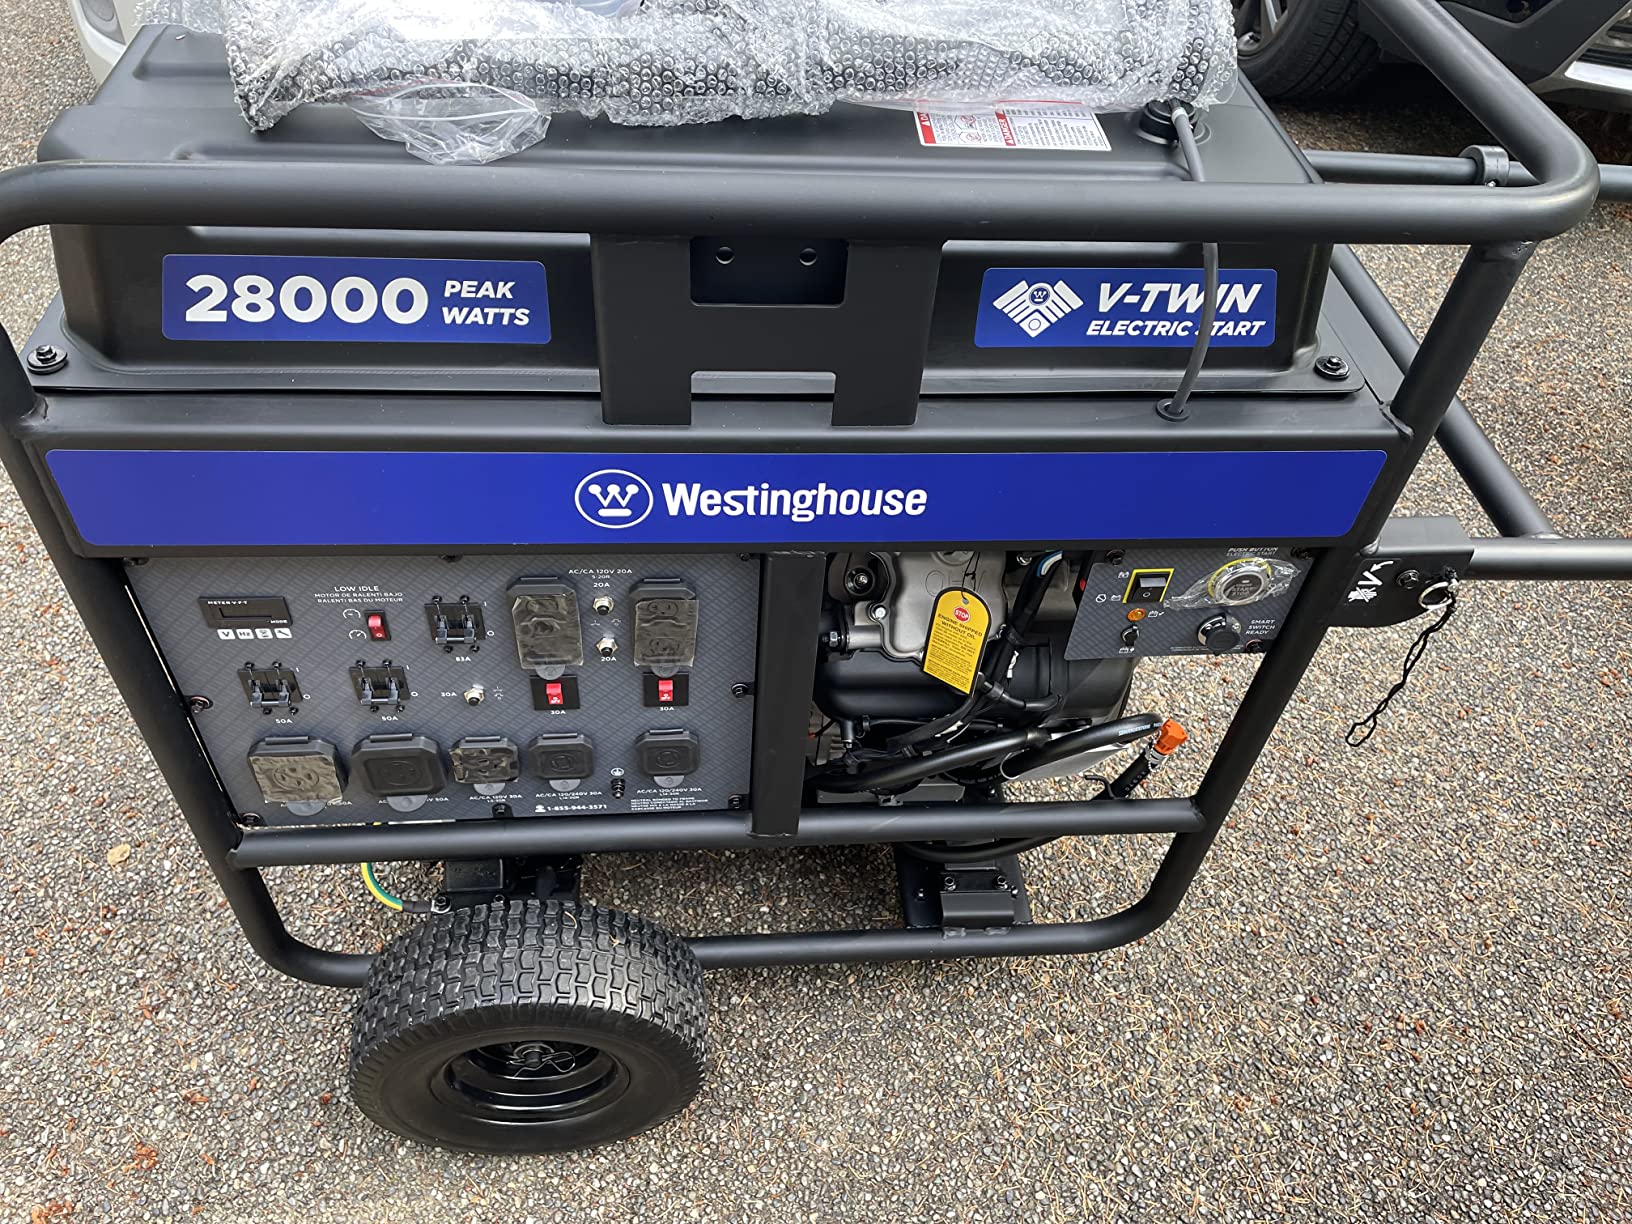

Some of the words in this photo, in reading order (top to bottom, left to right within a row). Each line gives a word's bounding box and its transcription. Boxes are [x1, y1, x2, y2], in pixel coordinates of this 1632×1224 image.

[185, 274, 429, 325] 28000
[443, 280, 516, 300] PEAK
[1098, 283, 1263, 314] V-TWIN
[441, 307, 531, 326] WATTS
[1086, 320, 1191, 337] ELECTRIC
[1194, 320, 1267, 336] TART
[661, 482, 928, 523] Westinghouse
[954, 609, 970, 619] STOP
[938, 613, 959, 625] ENGINE
[959, 622, 983, 637] SHIPPED
[941, 620, 966, 634] WITHOUT
